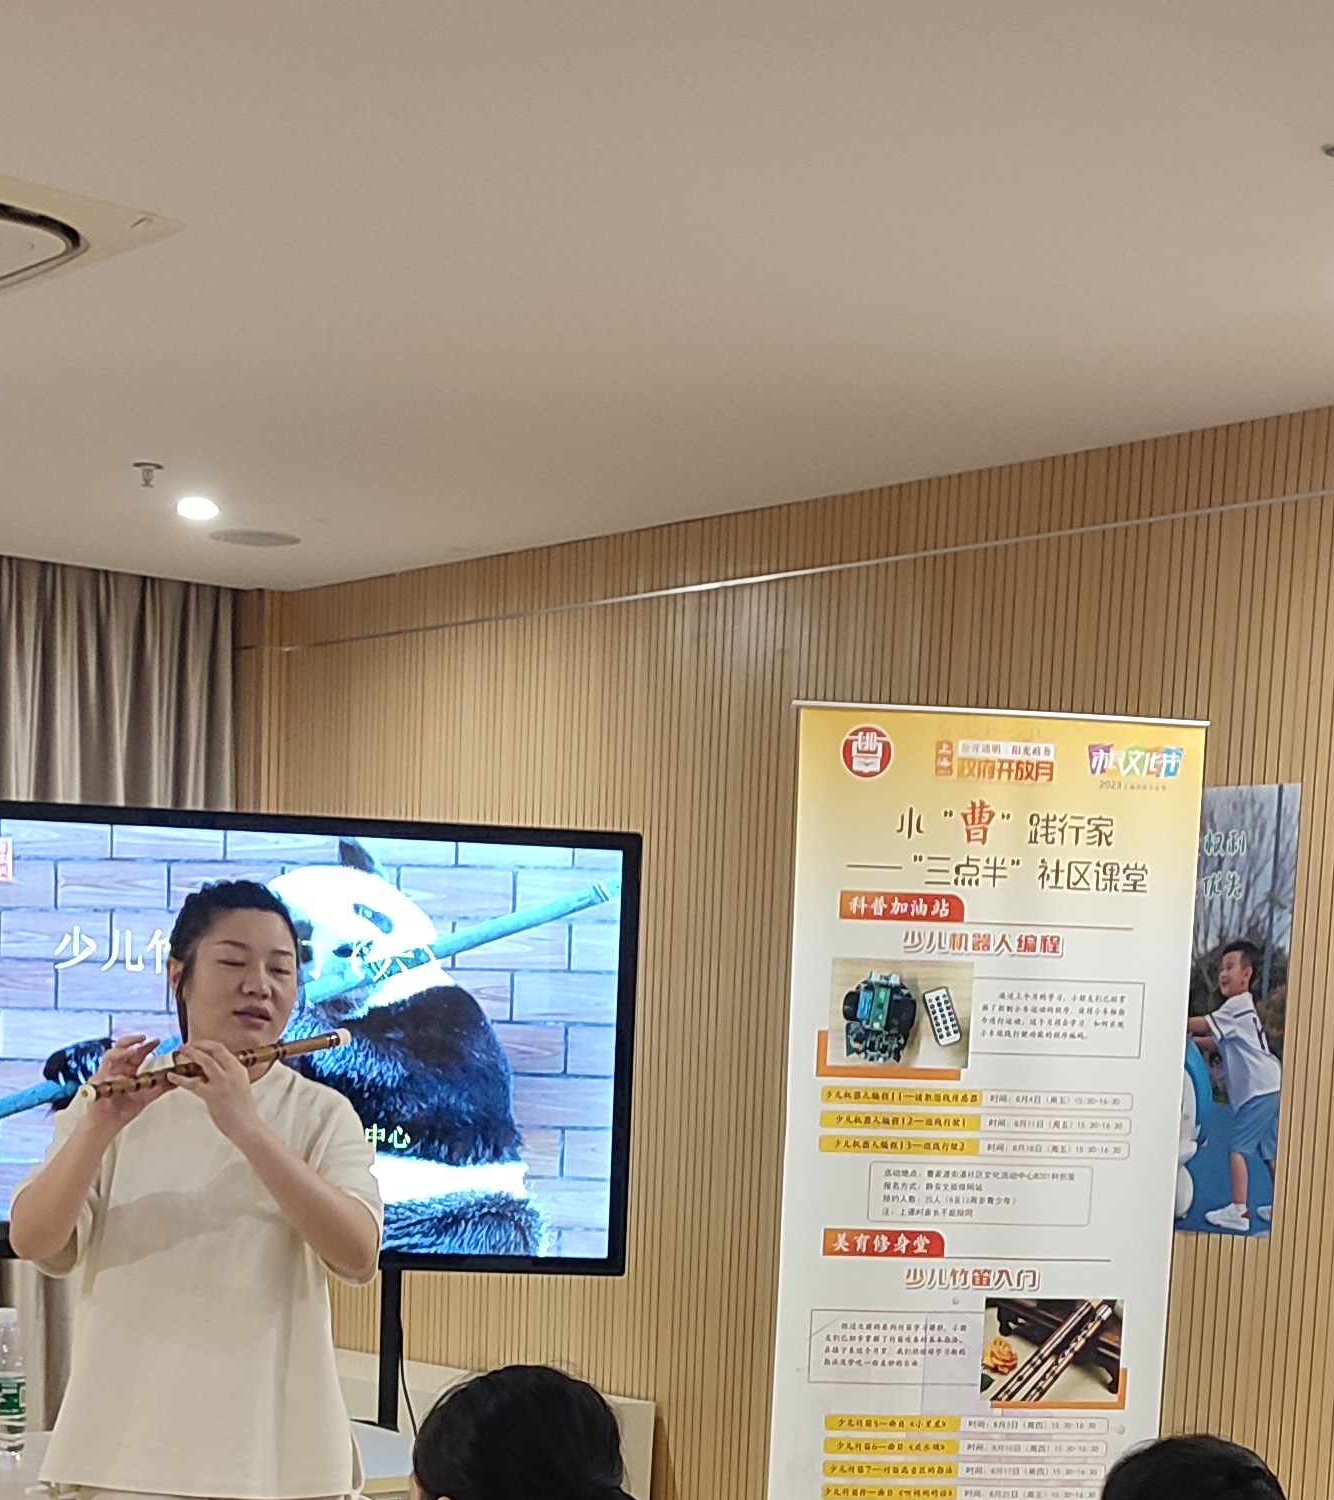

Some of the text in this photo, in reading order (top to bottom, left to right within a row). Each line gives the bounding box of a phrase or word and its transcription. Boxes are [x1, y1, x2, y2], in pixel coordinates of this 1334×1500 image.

[957, 758, 1055, 782] 政府开放月
[848, 895, 951, 918] 科普加油站
[903, 930, 1065, 957] 少儿机器人编程
[832, 1232, 932, 1254] 美育修身堂
[905, 1267, 1041, 1290] 少儿竹笛入门
